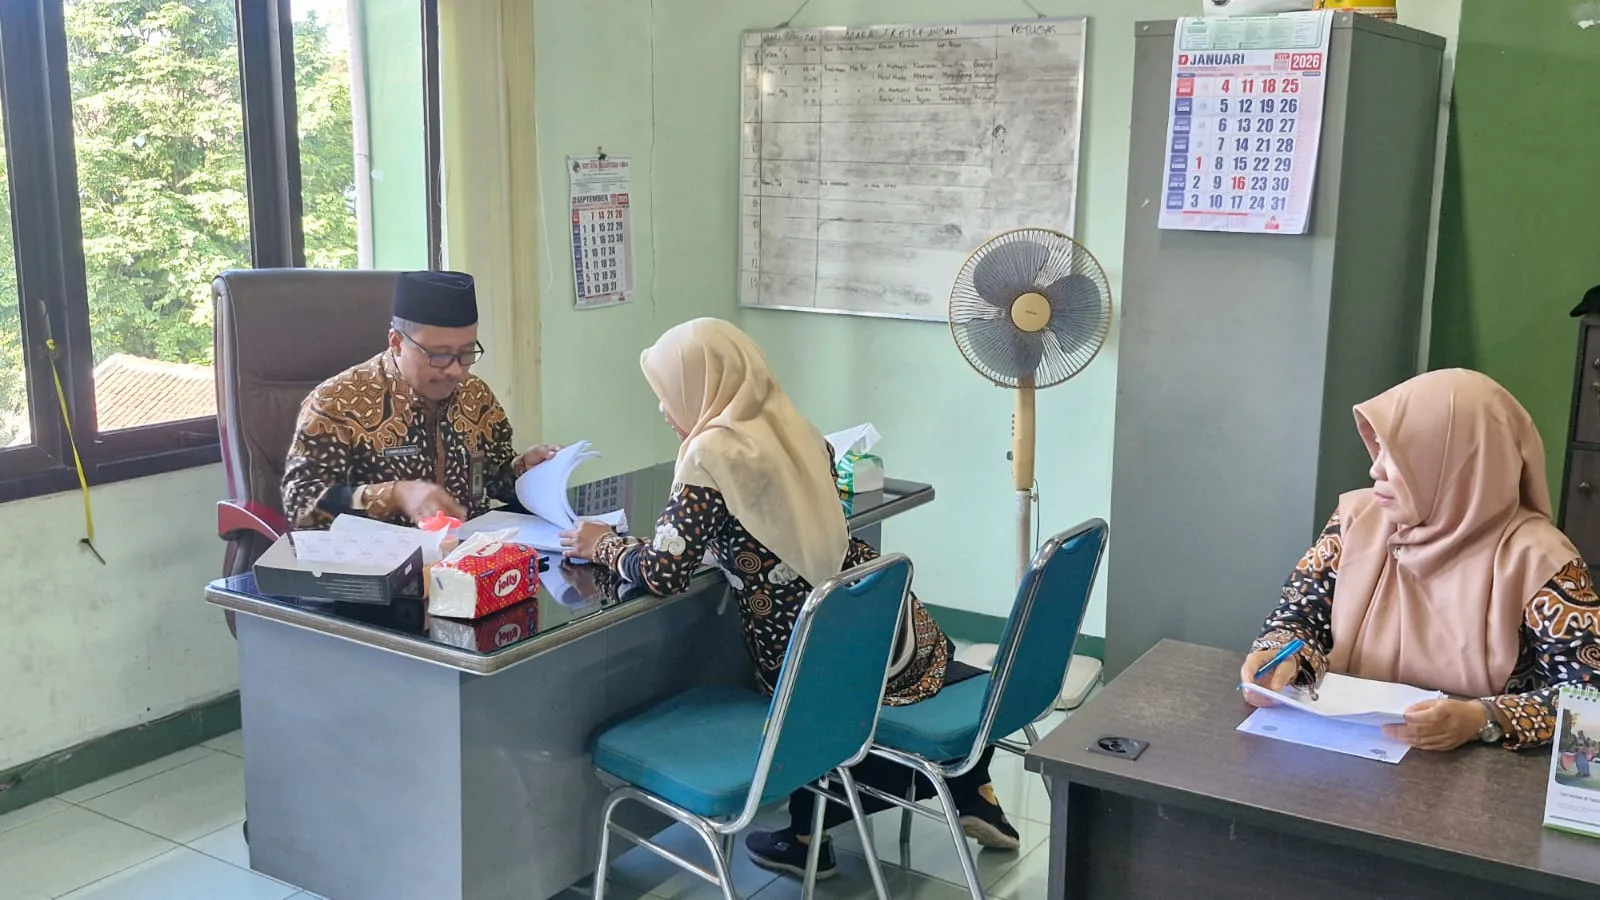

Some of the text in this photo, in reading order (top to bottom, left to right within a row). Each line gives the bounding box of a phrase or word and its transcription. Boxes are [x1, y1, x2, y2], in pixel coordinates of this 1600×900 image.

[1011, 25, 1057, 35] PETUGAS
[1190, 53, 1245, 65] JANUARI
[1292, 54, 1320, 68] 2026
[1222, 79, 1230, 93] 4
[1242, 80, 1253, 93] 11
[1262, 79, 1276, 93] 18
[1282, 79, 1299, 93] 25
[1220, 99, 1228, 113] 5
[1238, 99, 1252, 113] 12
[1259, 99, 1274, 113] 19
[1280, 99, 1297, 113] 26
[1218, 118, 1227, 132] 6
[1238, 118, 1250, 132] 13
[1257, 118, 1273, 132] 20
[1279, 119, 1295, 132] 27
[1218, 138, 1224, 151] 7
[1235, 138, 1248, 151] 14
[1256, 138, 1270, 152] 21
[1276, 138, 1293, 152] 28
[1195, 156, 1201, 169] 1
[1215, 157, 1223, 170] 8
[1233, 157, 1247, 171] 15
[1253, 157, 1269, 171] 22
[1274, 158, 1291, 172] 29
[1193, 176, 1200, 189] 2
[1214, 176, 1221, 189] 9
[1232, 176, 1245, 190] 16
[1251, 177, 1267, 191] 23
[1272, 177, 1288, 191] 30
[576, 194, 608, 204] SEPTEMBER
[1191, 194, 1198, 208] 3
[1209, 195, 1222, 208] 10
[1230, 195, 1243, 209] 17
[1250, 196, 1264, 210] 24
[1271, 196, 1286, 211] 31
[591, 212, 594, 221] 7
[607, 210, 613, 219] 21
[599, 224, 605, 232] 15
[607, 223, 614, 231] 22
[584, 238, 587, 246] 2
[592, 237, 596, 245] 9
[608, 235, 615, 243] 23
[616, 234, 623, 242] 30
[585, 250, 588, 258] 3
[601, 248, 606, 256] 17
[585, 262, 589, 270] 4
[593, 261, 598, 269] 11
[586, 274, 590, 282] 5
[594, 273, 599, 281] 12
[611, 282, 616, 291] 27
[498, 574, 518, 594] jolly
